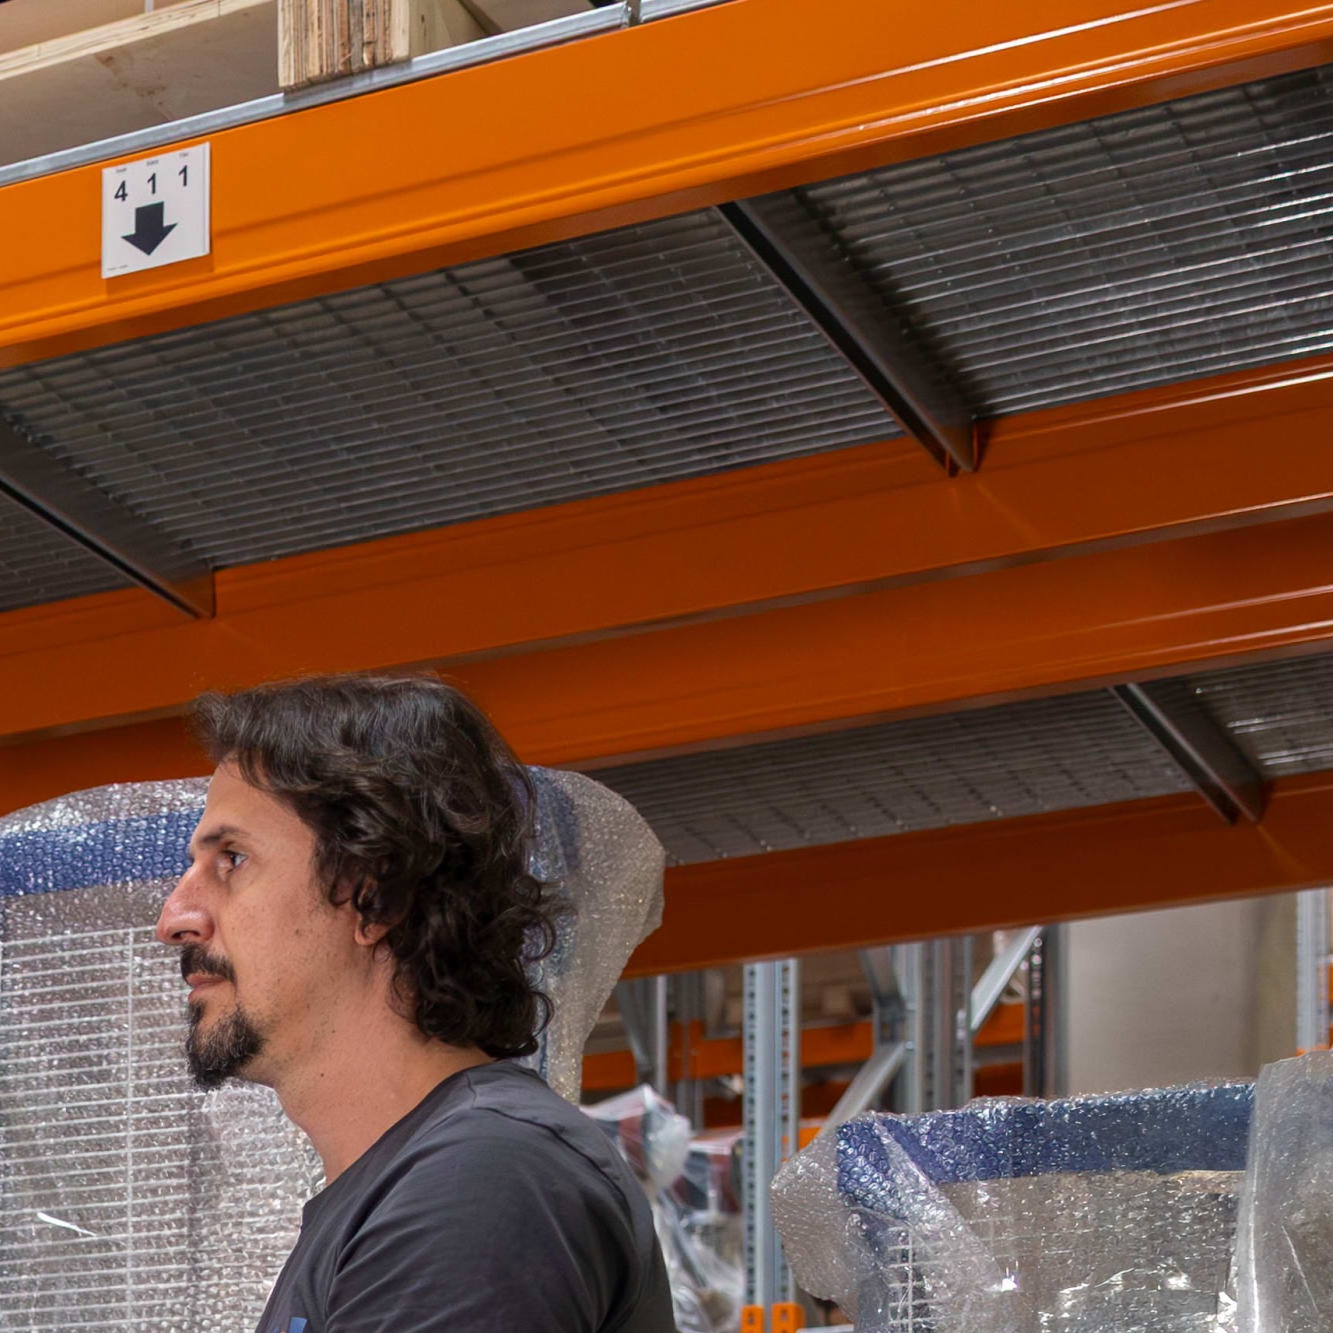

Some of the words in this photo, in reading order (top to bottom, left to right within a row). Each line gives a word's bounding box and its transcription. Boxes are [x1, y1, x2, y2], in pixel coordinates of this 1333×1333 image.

[114, 180, 128, 202] 4
[147, 172, 156, 195] 1
[178, 164, 188, 187] 1
